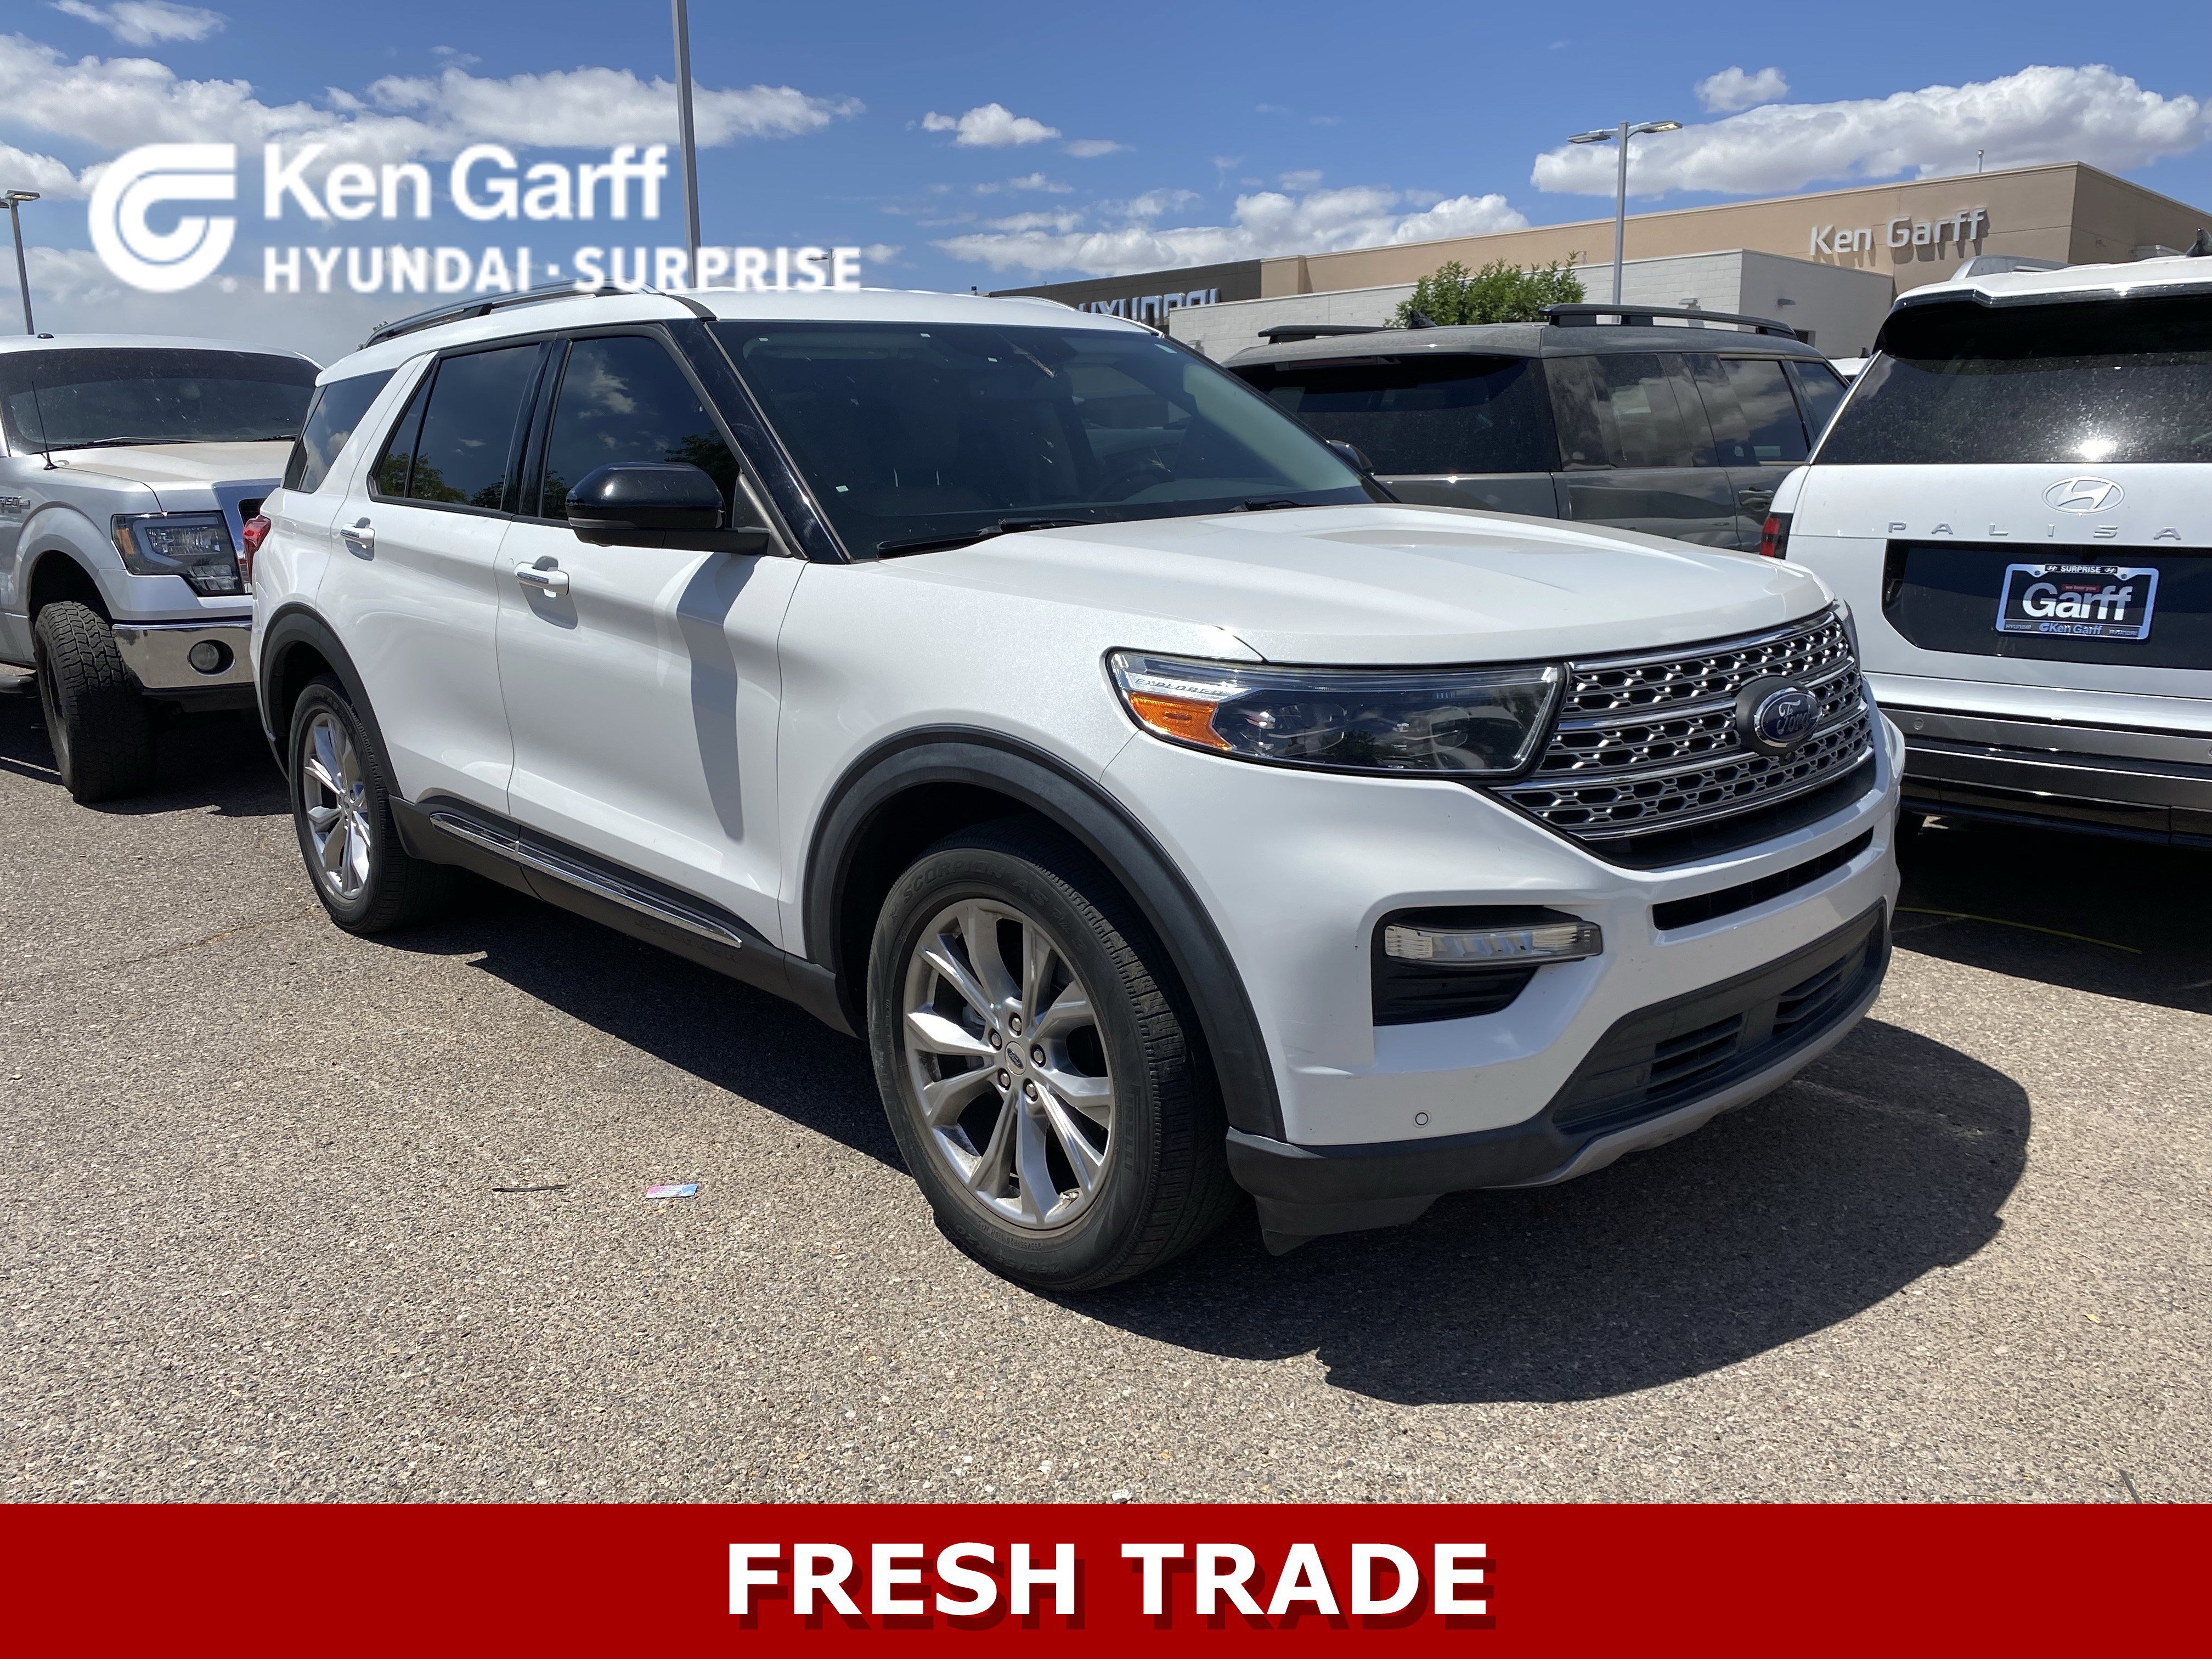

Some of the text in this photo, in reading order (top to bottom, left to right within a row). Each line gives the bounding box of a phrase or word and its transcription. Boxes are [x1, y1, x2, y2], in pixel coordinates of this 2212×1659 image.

[1810, 207, 1988, 256] Ken Garff
[1888, 521, 2182, 540] PALISA
[2023, 582, 2133, 620] Garff
[2048, 623, 2102, 635] Ken Garff
[1776, 699, 1812, 736] Ford
[904, 860, 1006, 904] SCORPION
[1012, 878, 1049, 907] AS
